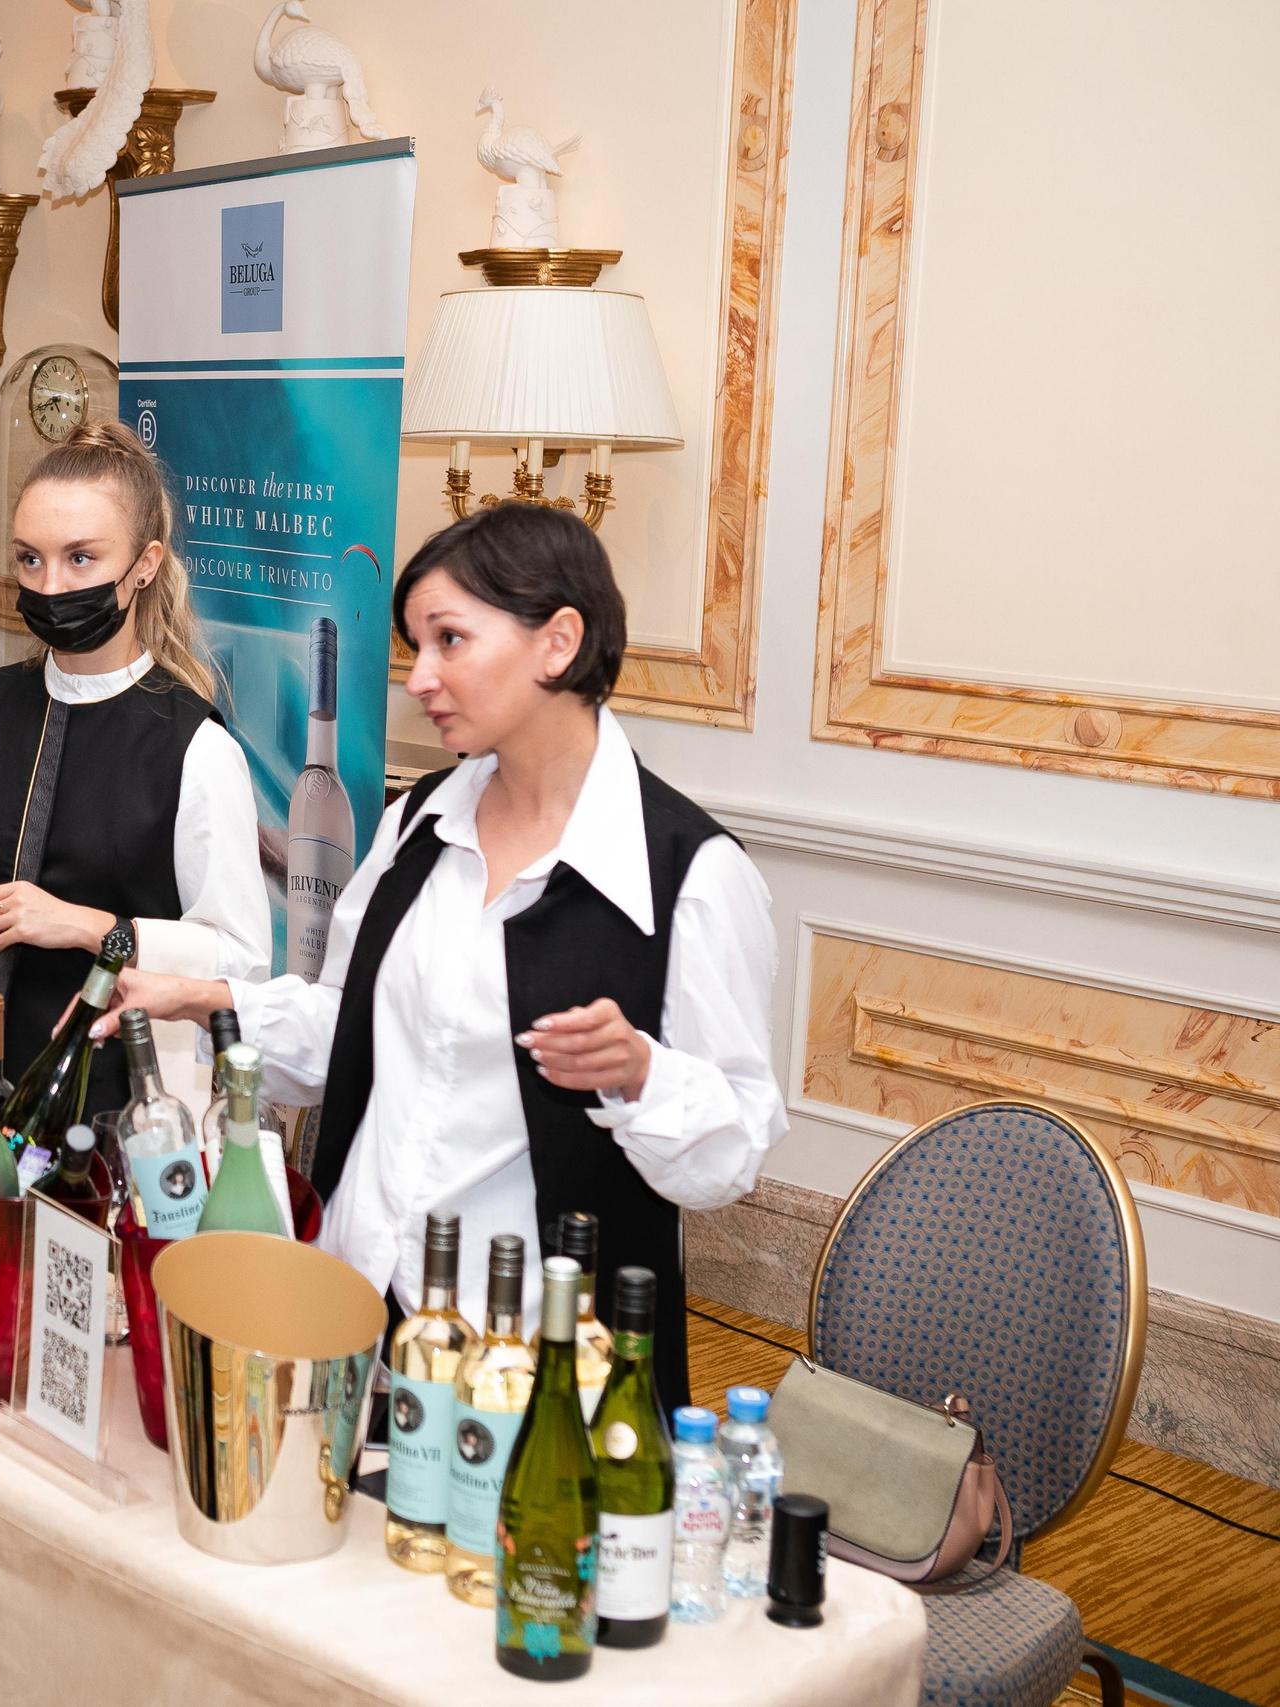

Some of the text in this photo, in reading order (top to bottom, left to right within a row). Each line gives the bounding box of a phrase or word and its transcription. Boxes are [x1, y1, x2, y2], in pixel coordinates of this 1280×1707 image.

[229, 262, 275, 284] BELUGA
[243, 287, 261, 297] GROUP
[137, 399, 157, 408] Certified
[186, 471, 335, 502] DISCOVER the FIRST
[186, 505, 333, 538] WHITE MALBEC
[186, 556, 333, 591] DISCOVER TRIVENTO
[296, 895, 333, 910] ARGENTIN
[305, 926, 325, 939] WHITE
[299, 936, 326, 952] MALBE
